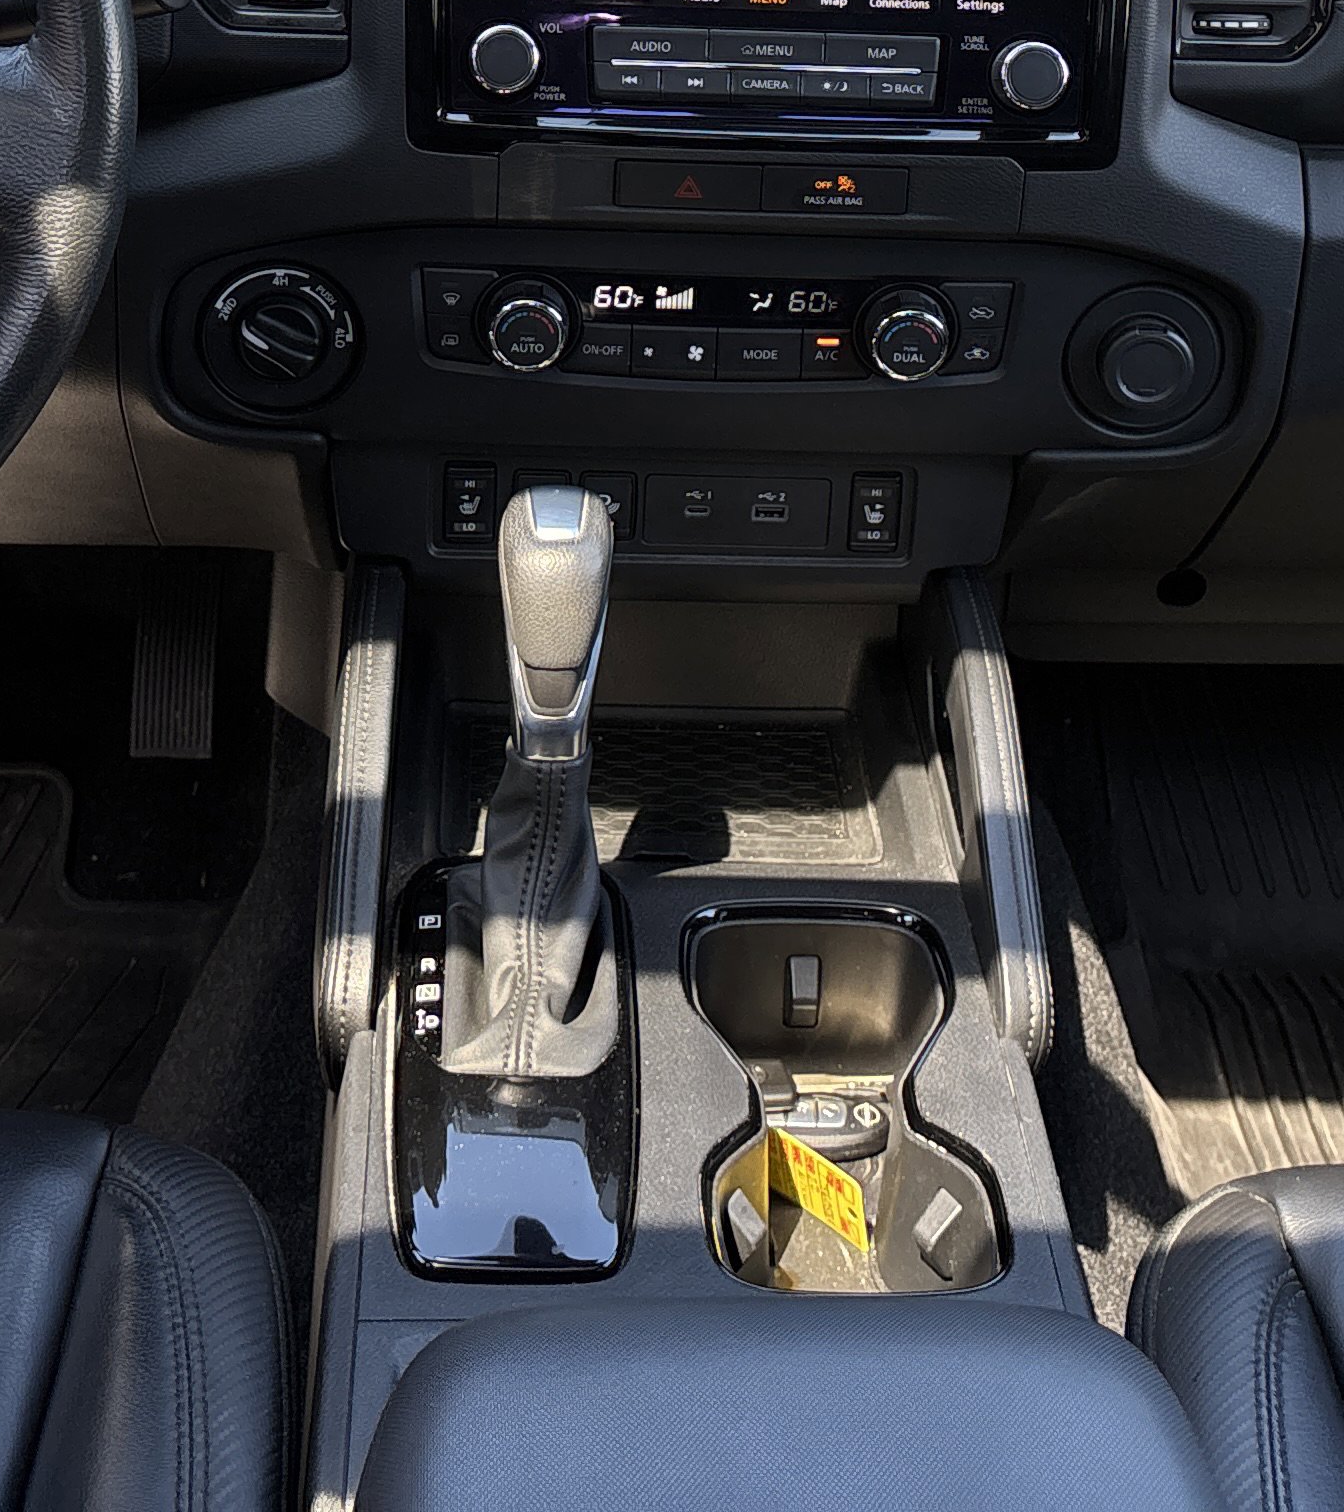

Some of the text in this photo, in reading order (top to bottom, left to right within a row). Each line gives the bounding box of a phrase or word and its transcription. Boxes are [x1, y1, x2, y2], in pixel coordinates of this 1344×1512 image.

[539, 22, 563, 34] VOL
[630, 40, 672, 53] AUDIO
[756, 44, 794, 56] MENU
[960, 43, 990, 51] SCROLL
[867, 47, 897, 60] MAP
[742, 78, 789, 90] CAMERA
[894, 83, 925, 95] BACK
[533, 92, 567, 101] POWER
[961, 97, 989, 106] ENTER
[957, 105, 993, 114] SETTING
[815, 180, 833, 189] OFF
[803, 195, 863, 206] PASS AIR BAG
[272, 276, 288, 286] 4H
[315, 284, 337, 306] PUSH
[217, 297, 237, 322] 2WD
[334, 326, 348, 349] 4LO
[510, 343, 545, 354] AUTO
[582, 343, 624, 356] ON-OFF
[742, 349, 779, 361] MODE
[814, 349, 839, 361] A/C
[892, 352, 926, 364] DUAL
[462, 523, 476, 531] LO
[867, 530, 881, 539] LO
[420, 957, 436, 974] R
[425, 1015, 440, 1029] D
